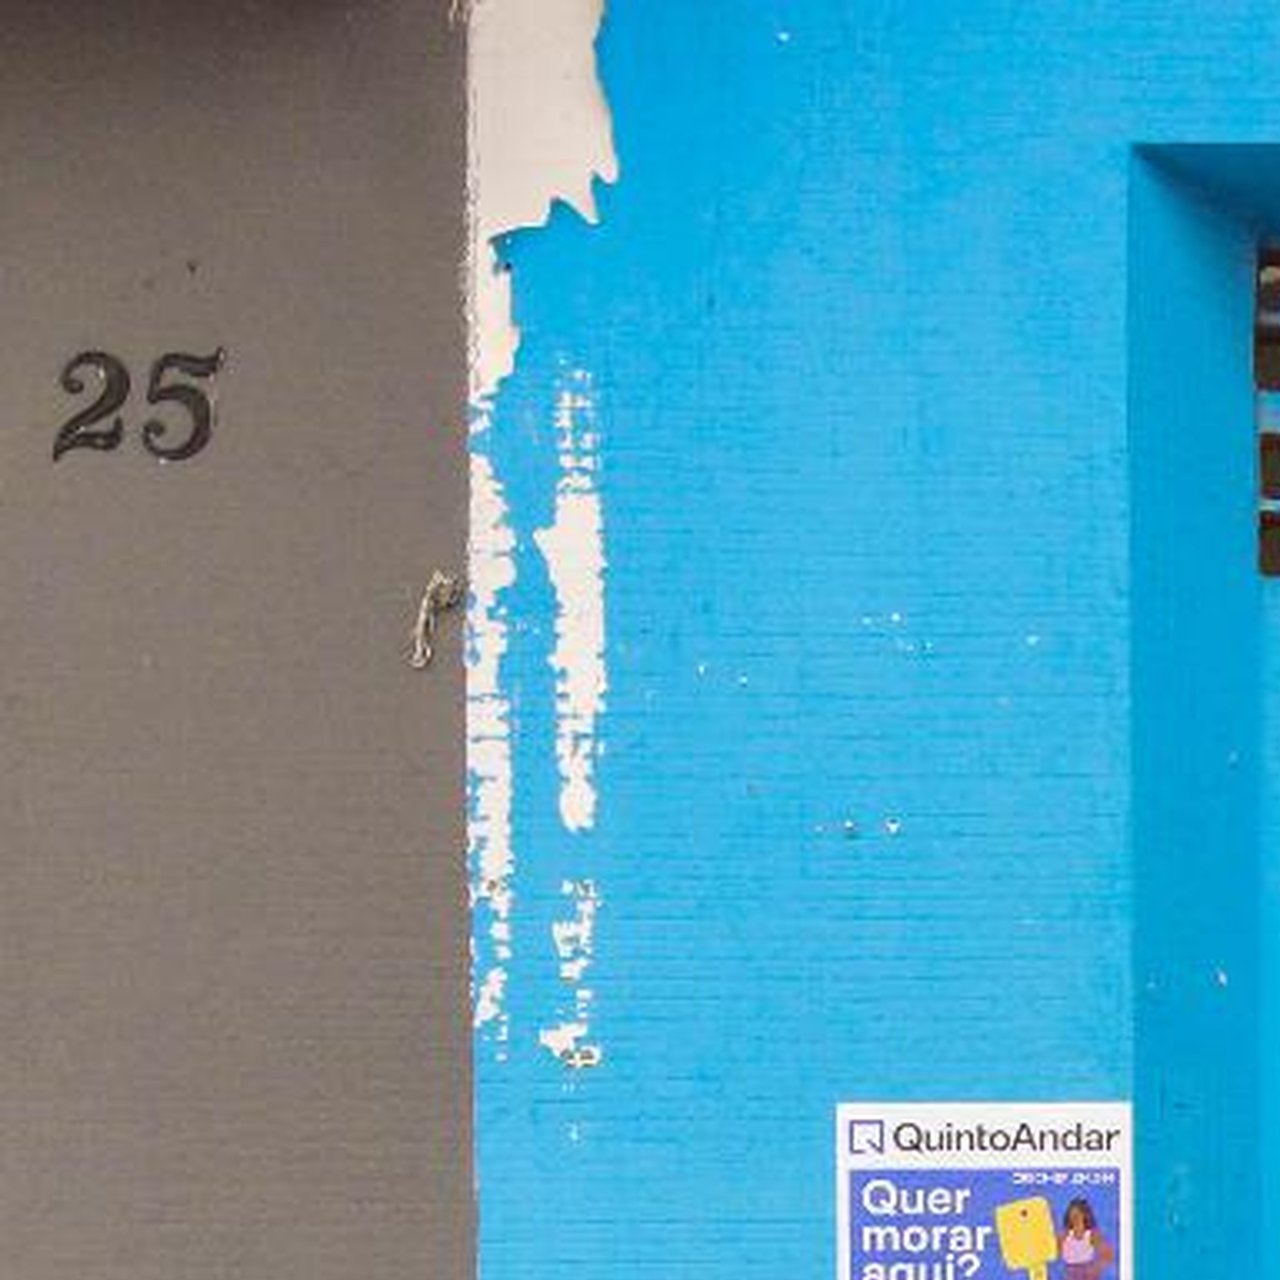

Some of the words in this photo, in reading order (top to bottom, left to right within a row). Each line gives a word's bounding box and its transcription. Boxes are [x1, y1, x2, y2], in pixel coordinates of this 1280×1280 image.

[53, 348, 224, 462] 25
[893, 1122, 1121, 1153] QuintoAndar
[862, 1180, 970, 1216] Quer
[862, 1226, 993, 1252] morar
